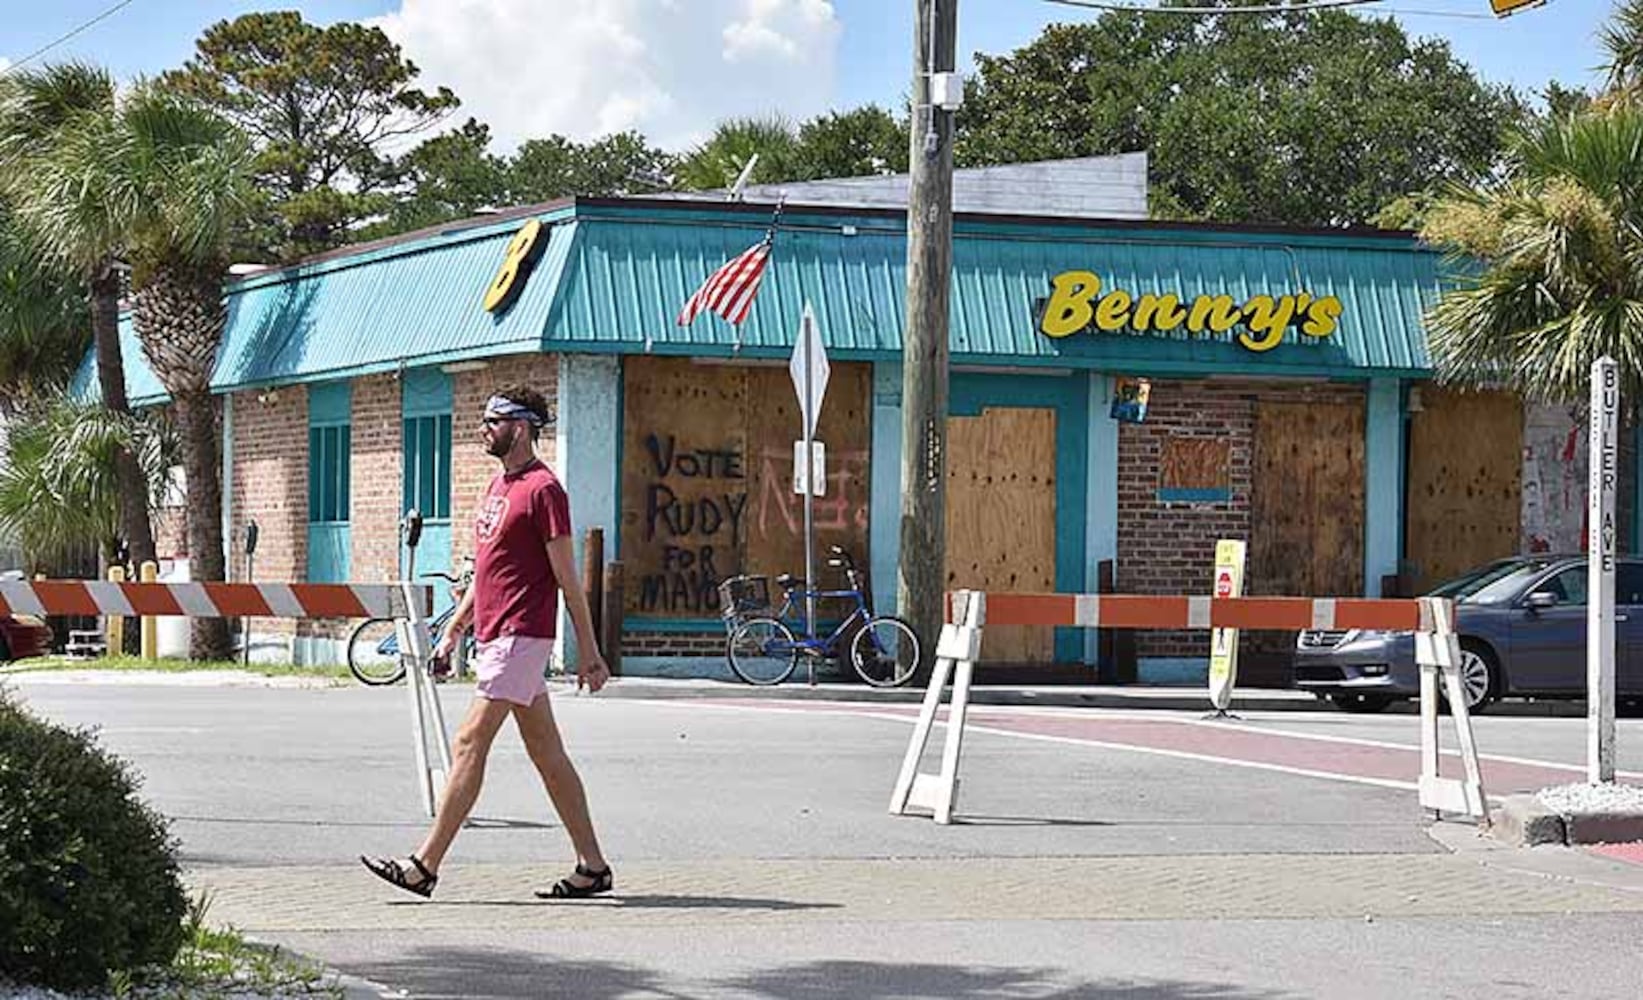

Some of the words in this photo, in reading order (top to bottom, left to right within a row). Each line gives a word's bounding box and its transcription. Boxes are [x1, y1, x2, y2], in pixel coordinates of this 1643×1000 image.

[1041, 270, 1344, 351] Benny's
[1603, 370, 1616, 491] BUTLER
[663, 546, 717, 580] FOR
[1602, 513, 1614, 572] AVE
[640, 571, 723, 612] MAYO
